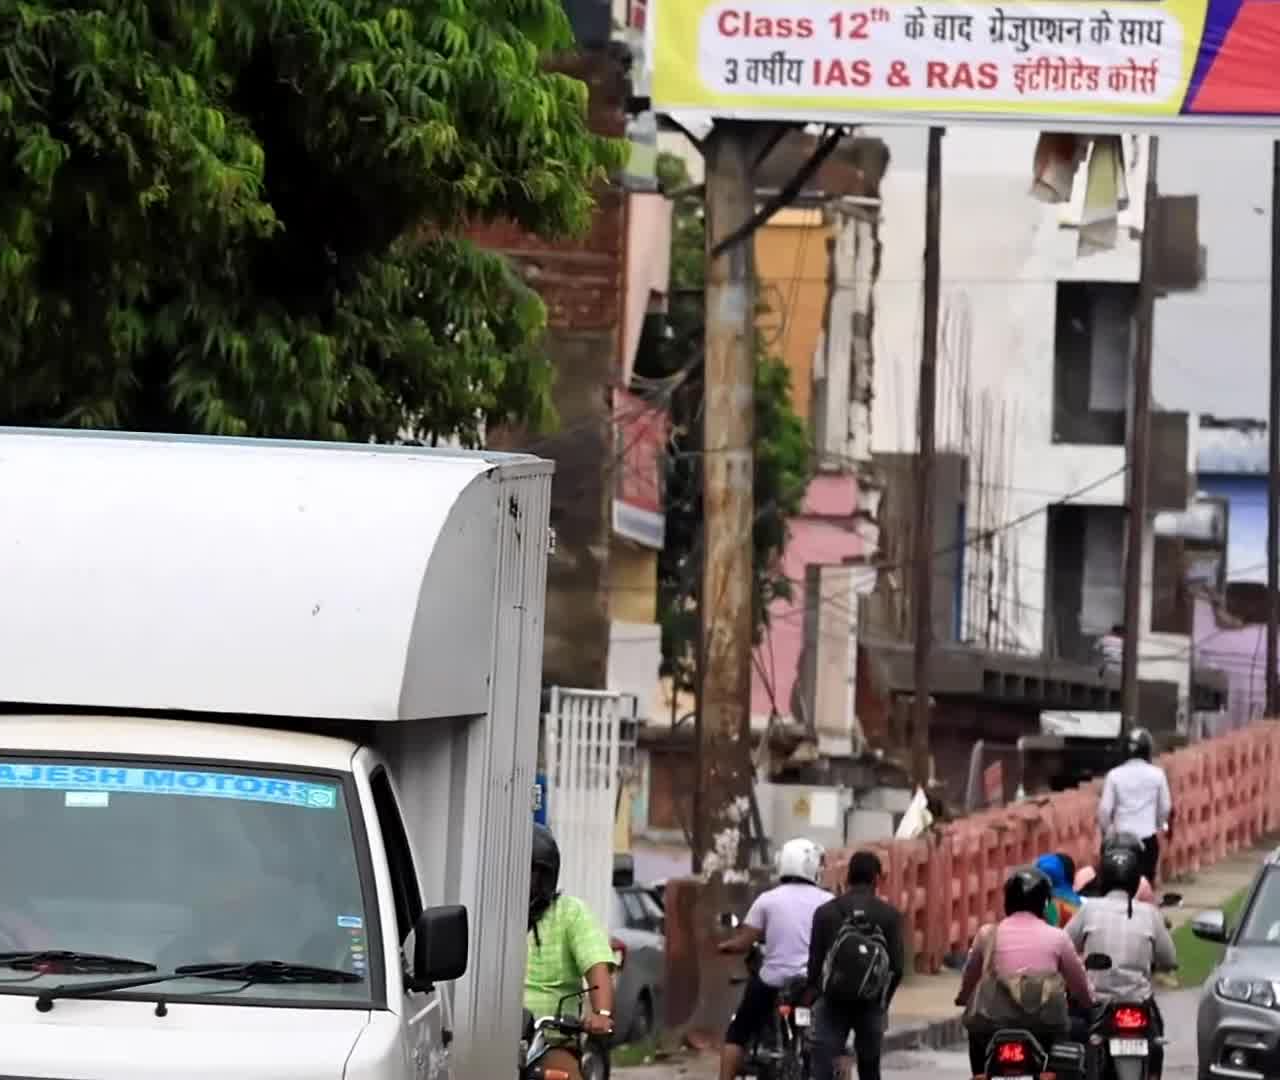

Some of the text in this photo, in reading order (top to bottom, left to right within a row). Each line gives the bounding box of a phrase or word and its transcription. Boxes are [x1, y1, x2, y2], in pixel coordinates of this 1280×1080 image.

[716, 9, 814, 38] Class
[829, 7, 890, 40] 12th
[904, 7, 927, 41] के
[933, 13, 974, 43] बाद
[1090, 10, 1114, 45] के
[1119, 18, 1165, 46] साथ
[724, 57, 739, 85] 3
[745, 51, 804, 86] वर्षीय
[812, 58, 872, 87] IAS
[886, 59, 911, 87] &
[926, 61, 999, 90] RAS
[1108, 58, 1159, 94] कोर्स
